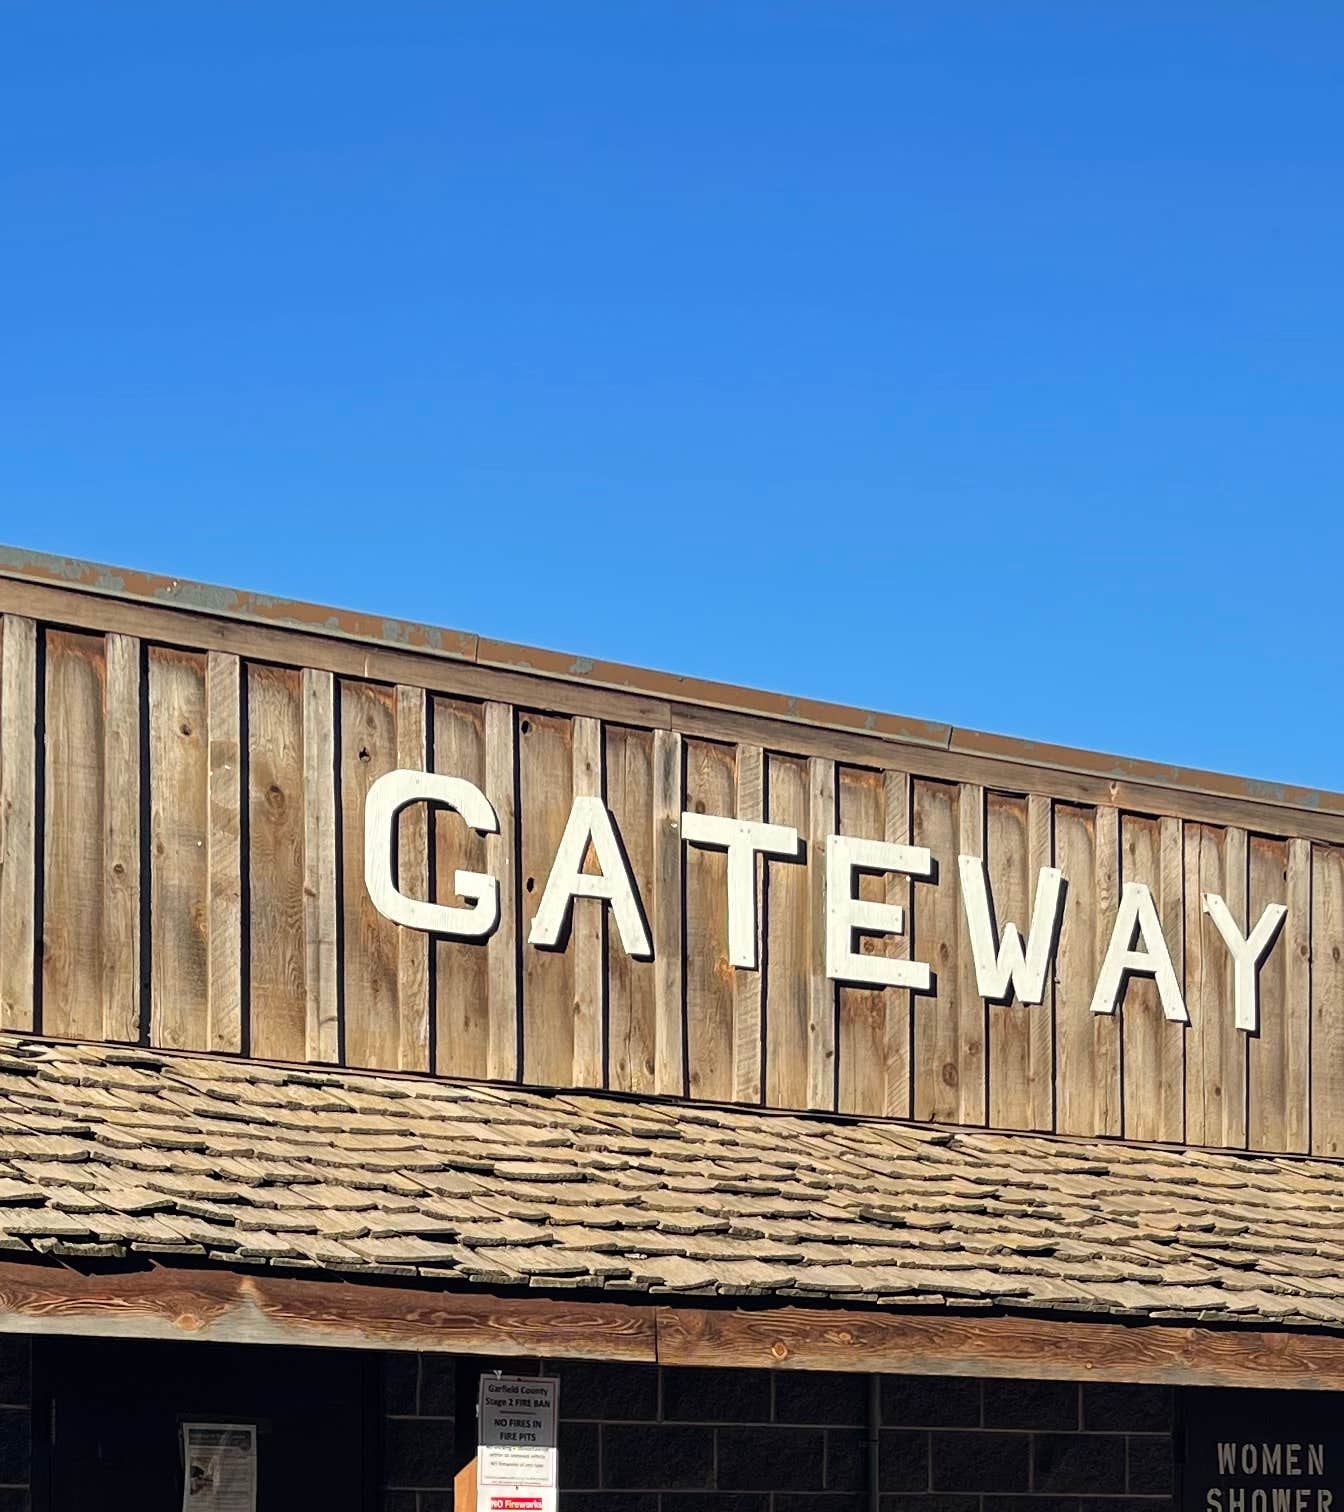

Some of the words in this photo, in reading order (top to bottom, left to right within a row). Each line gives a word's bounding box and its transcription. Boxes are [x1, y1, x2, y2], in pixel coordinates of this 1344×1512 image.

[364, 768, 1288, 1031] GATEWAY
[488, 1384, 518, 1394] Garfield
[520, 1386, 548, 1396] County
[485, 1397, 507, 1407] Stage
[508, 1398, 513, 1407] 2
[515, 1399, 532, 1407] FIRE
[533, 1399, 550, 1408] BAN
[494, 1418, 507, 1427] NO
[509, 1419, 531, 1428] FIRES
[533, 1420, 542, 1428] IN
[500, 1432, 517, 1441] FIRE
[519, 1433, 536, 1441] PITS
[1217, 1442, 1324, 1476] WOMEN
[491, 1501, 504, 1509] NO
[505, 1501, 542, 1509] Fireworks
